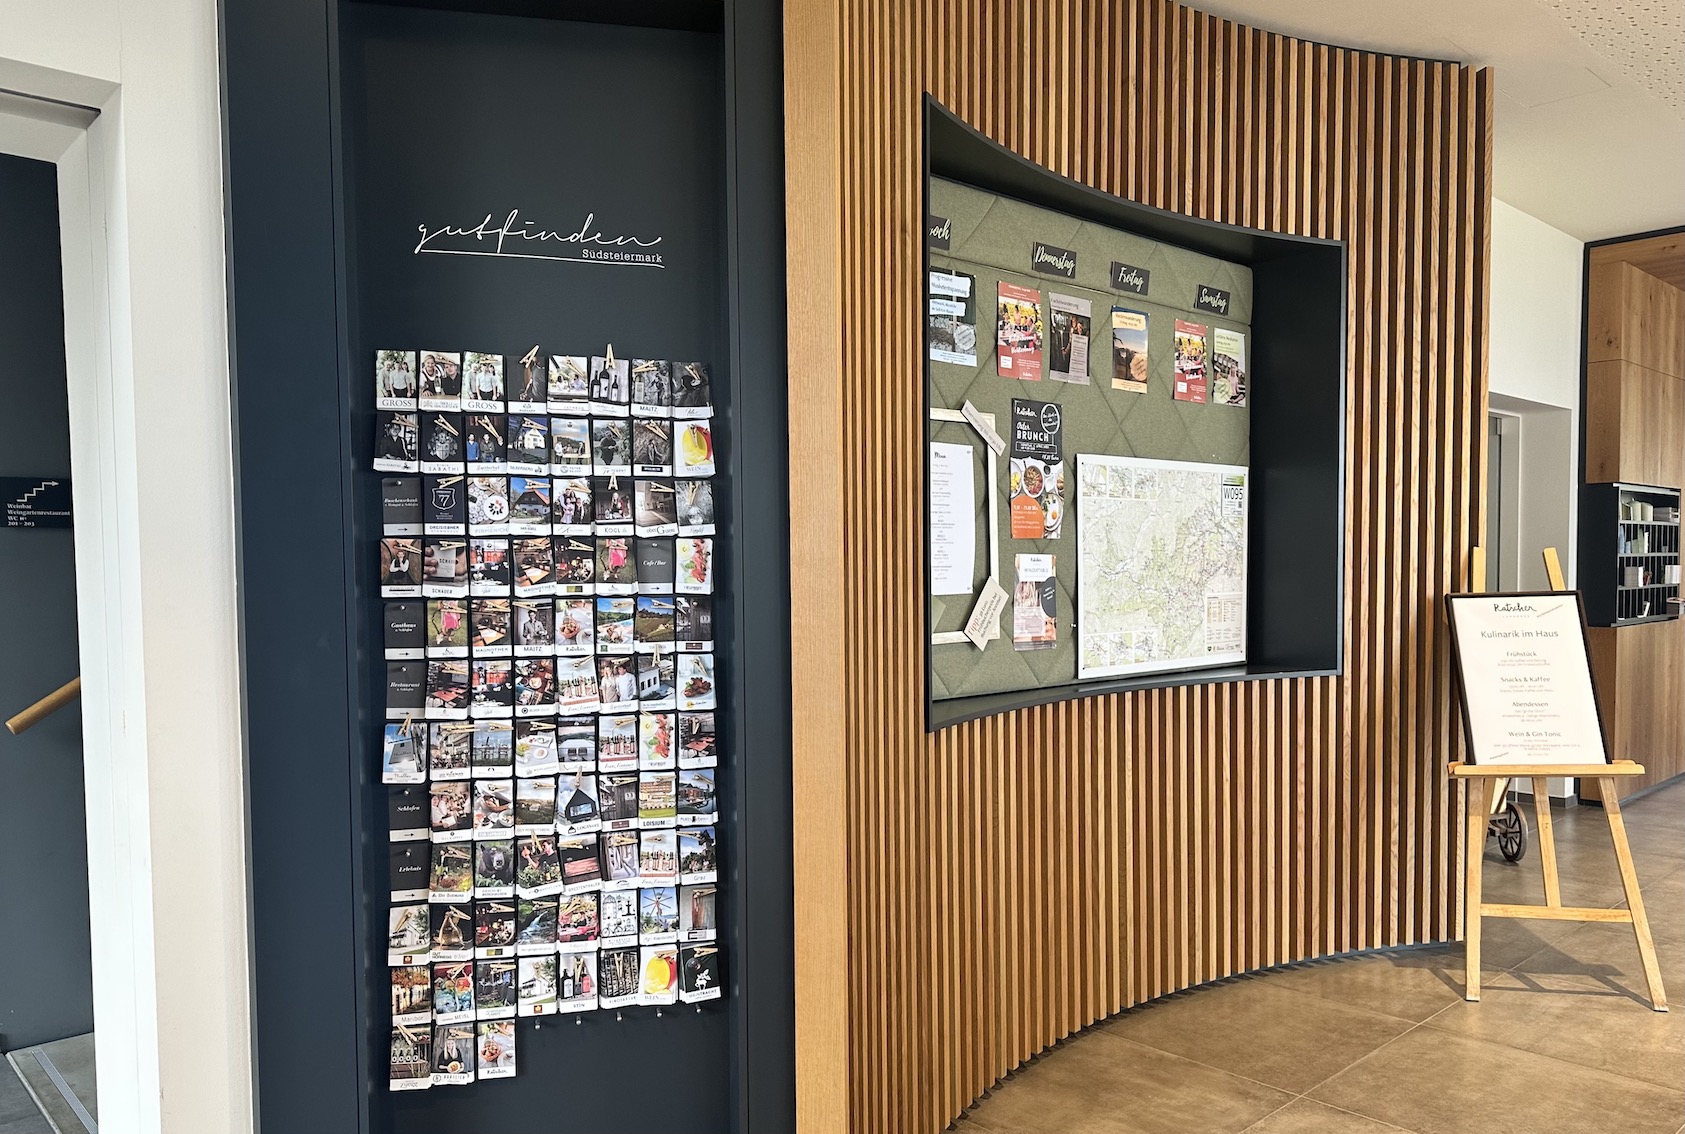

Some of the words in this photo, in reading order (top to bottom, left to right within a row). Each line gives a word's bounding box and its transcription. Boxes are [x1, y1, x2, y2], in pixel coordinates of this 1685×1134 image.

[414, 209, 663, 254] gutfinden
[582, 248, 663, 264] Südsteiermark
[1034, 246, 1076, 276] Donnerstag
[1118, 266, 1145, 293] Freitag
[1199, 288, 1228, 314] Samstag
[381, 399, 412, 408] GROSS
[467, 401, 498, 411] GROSS
[1016, 430, 1049, 442] BRUNCH
[1223, 487, 1244, 500] W095
[7, 509, 71, 517] Weingartenrestaurant
[431, 587, 453, 595] SCHAUER
[1493, 602, 1537, 613] Ratscher
[1480, 630, 1520, 639] Kulinarik
[1521, 630, 1534, 638] im
[1535, 629, 1559, 638] Haus
[390, 681, 421, 689] Restaurant
[398, 865, 422, 873] Erlebnis
[401, 1015, 424, 1023] Maribor
